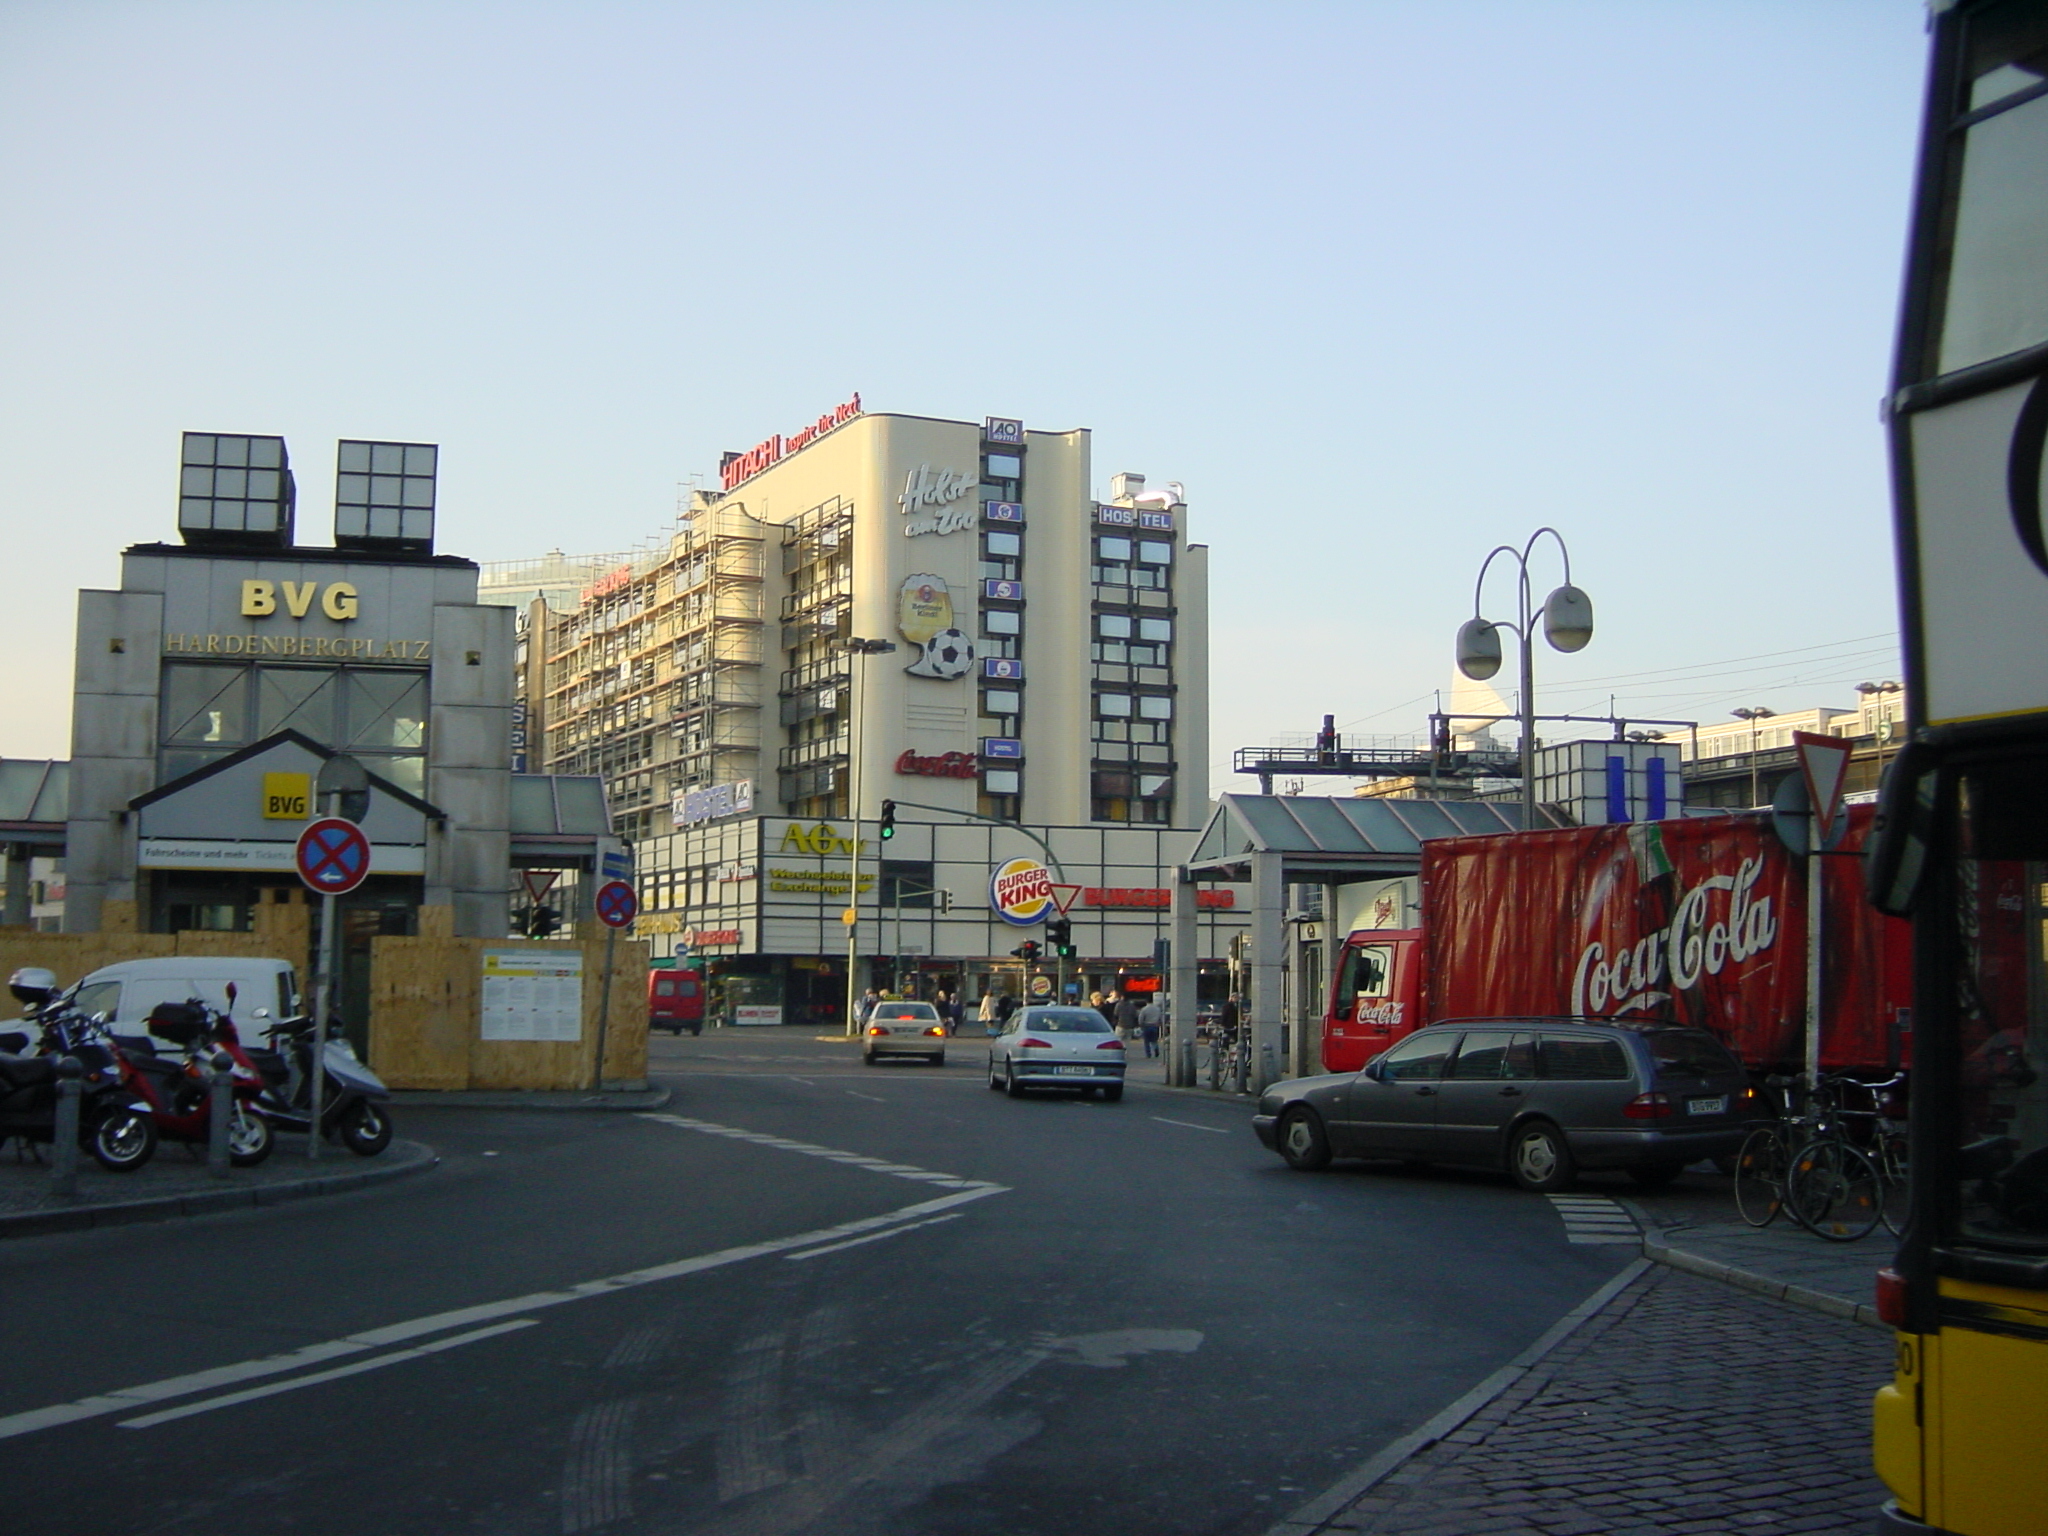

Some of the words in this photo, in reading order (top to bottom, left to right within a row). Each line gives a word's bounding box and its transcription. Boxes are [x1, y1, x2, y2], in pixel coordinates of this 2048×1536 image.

[993, 421, 1016, 436] AO
[721, 434, 780, 491] HITACHI
[241, 579, 359, 620] BVG
[166, 632, 431, 659] HARDENBERGPLATZ
[1606, 756, 1666, 824] U
[269, 796, 305, 814] BVG
[145, 848, 202, 858] Fahrscheine
[204, 849, 222, 858] und
[223, 849, 249, 859] mehr
[998, 868, 1049, 893] BURGER
[1000, 880, 1051, 909] KING
[1084, 887, 1171, 907] BURGER
[1571, 852, 1777, 1019] Coca-Cola
